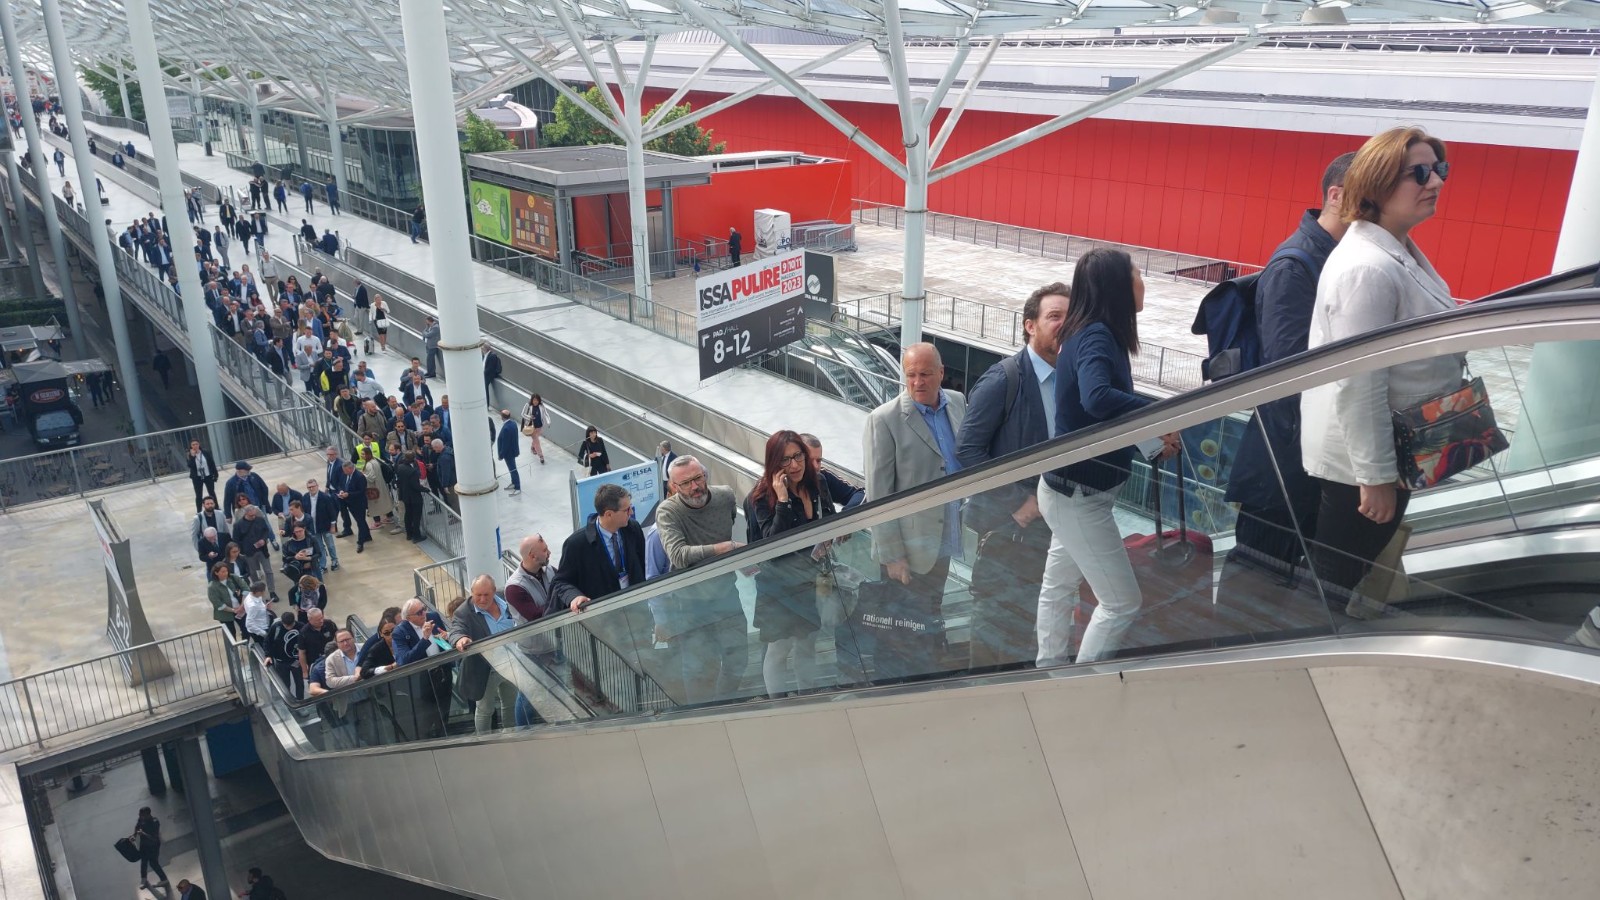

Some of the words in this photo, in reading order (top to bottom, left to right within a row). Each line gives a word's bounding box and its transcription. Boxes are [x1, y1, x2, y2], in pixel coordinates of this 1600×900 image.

[782, 261, 788, 271] 9
[796, 257, 802, 267] 11
[783, 278, 802, 292] 2023
[713, 330, 751, 363] 8-12
[632, 467, 652, 476] ELSEA
[863, 613, 892, 626] rationell
[895, 619, 926, 631] reinigen
